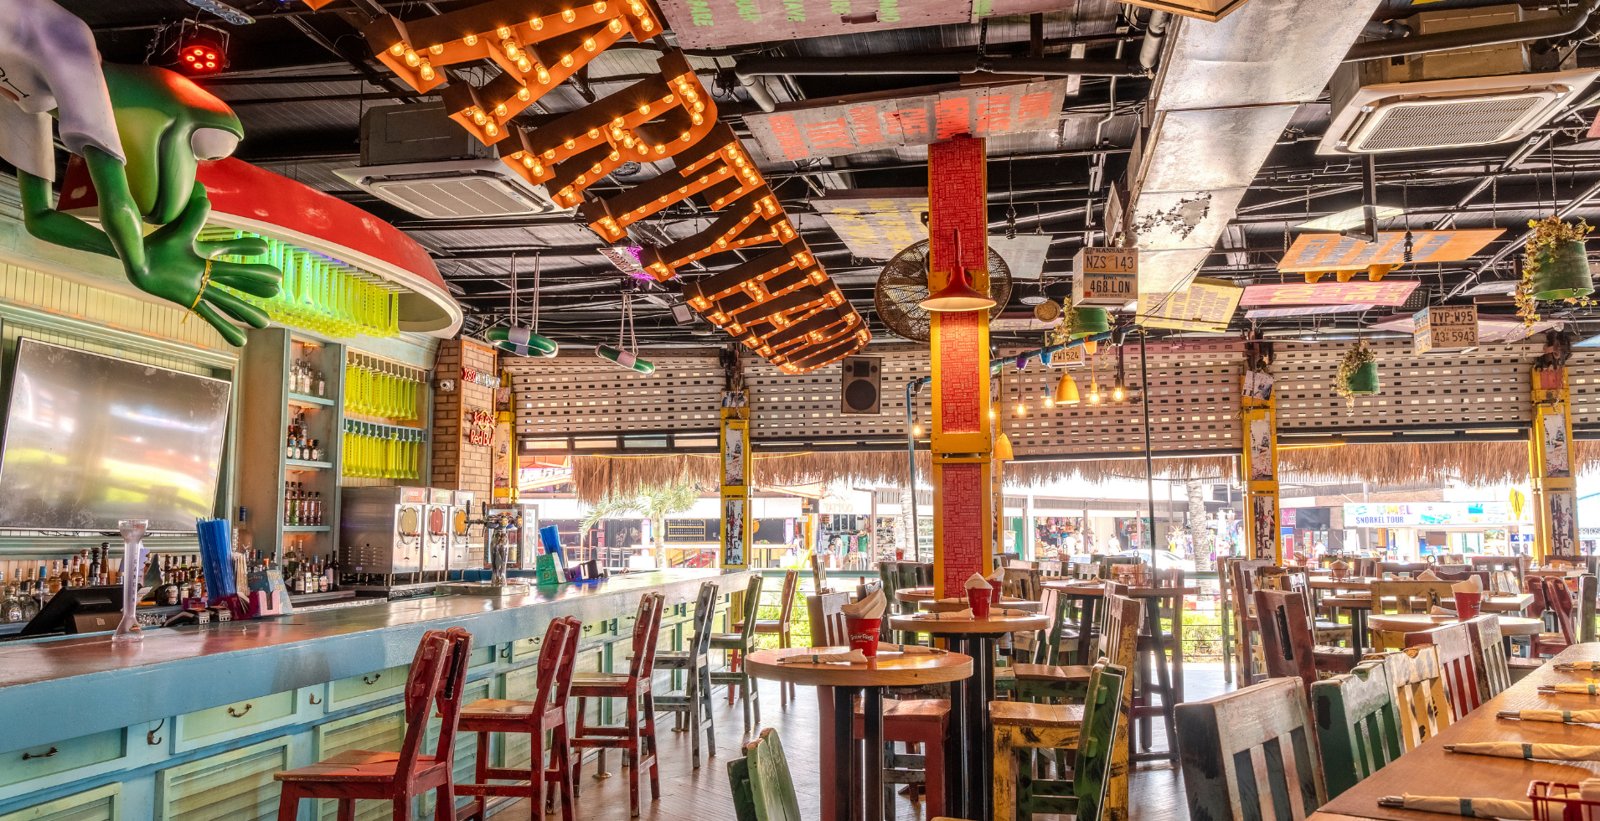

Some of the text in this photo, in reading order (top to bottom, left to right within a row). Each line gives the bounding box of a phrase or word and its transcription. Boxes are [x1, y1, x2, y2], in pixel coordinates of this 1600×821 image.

[303, 0, 797, 281] ARTY
[1086, 255, 1134, 269] NZS 143
[1090, 280, 1130, 293] 468 LON
[685, 247, 872, 374] HARD
[1451, 331, 1475, 342] 5943
[1355, 516, 1404, 524] SNORKEL TOUR
